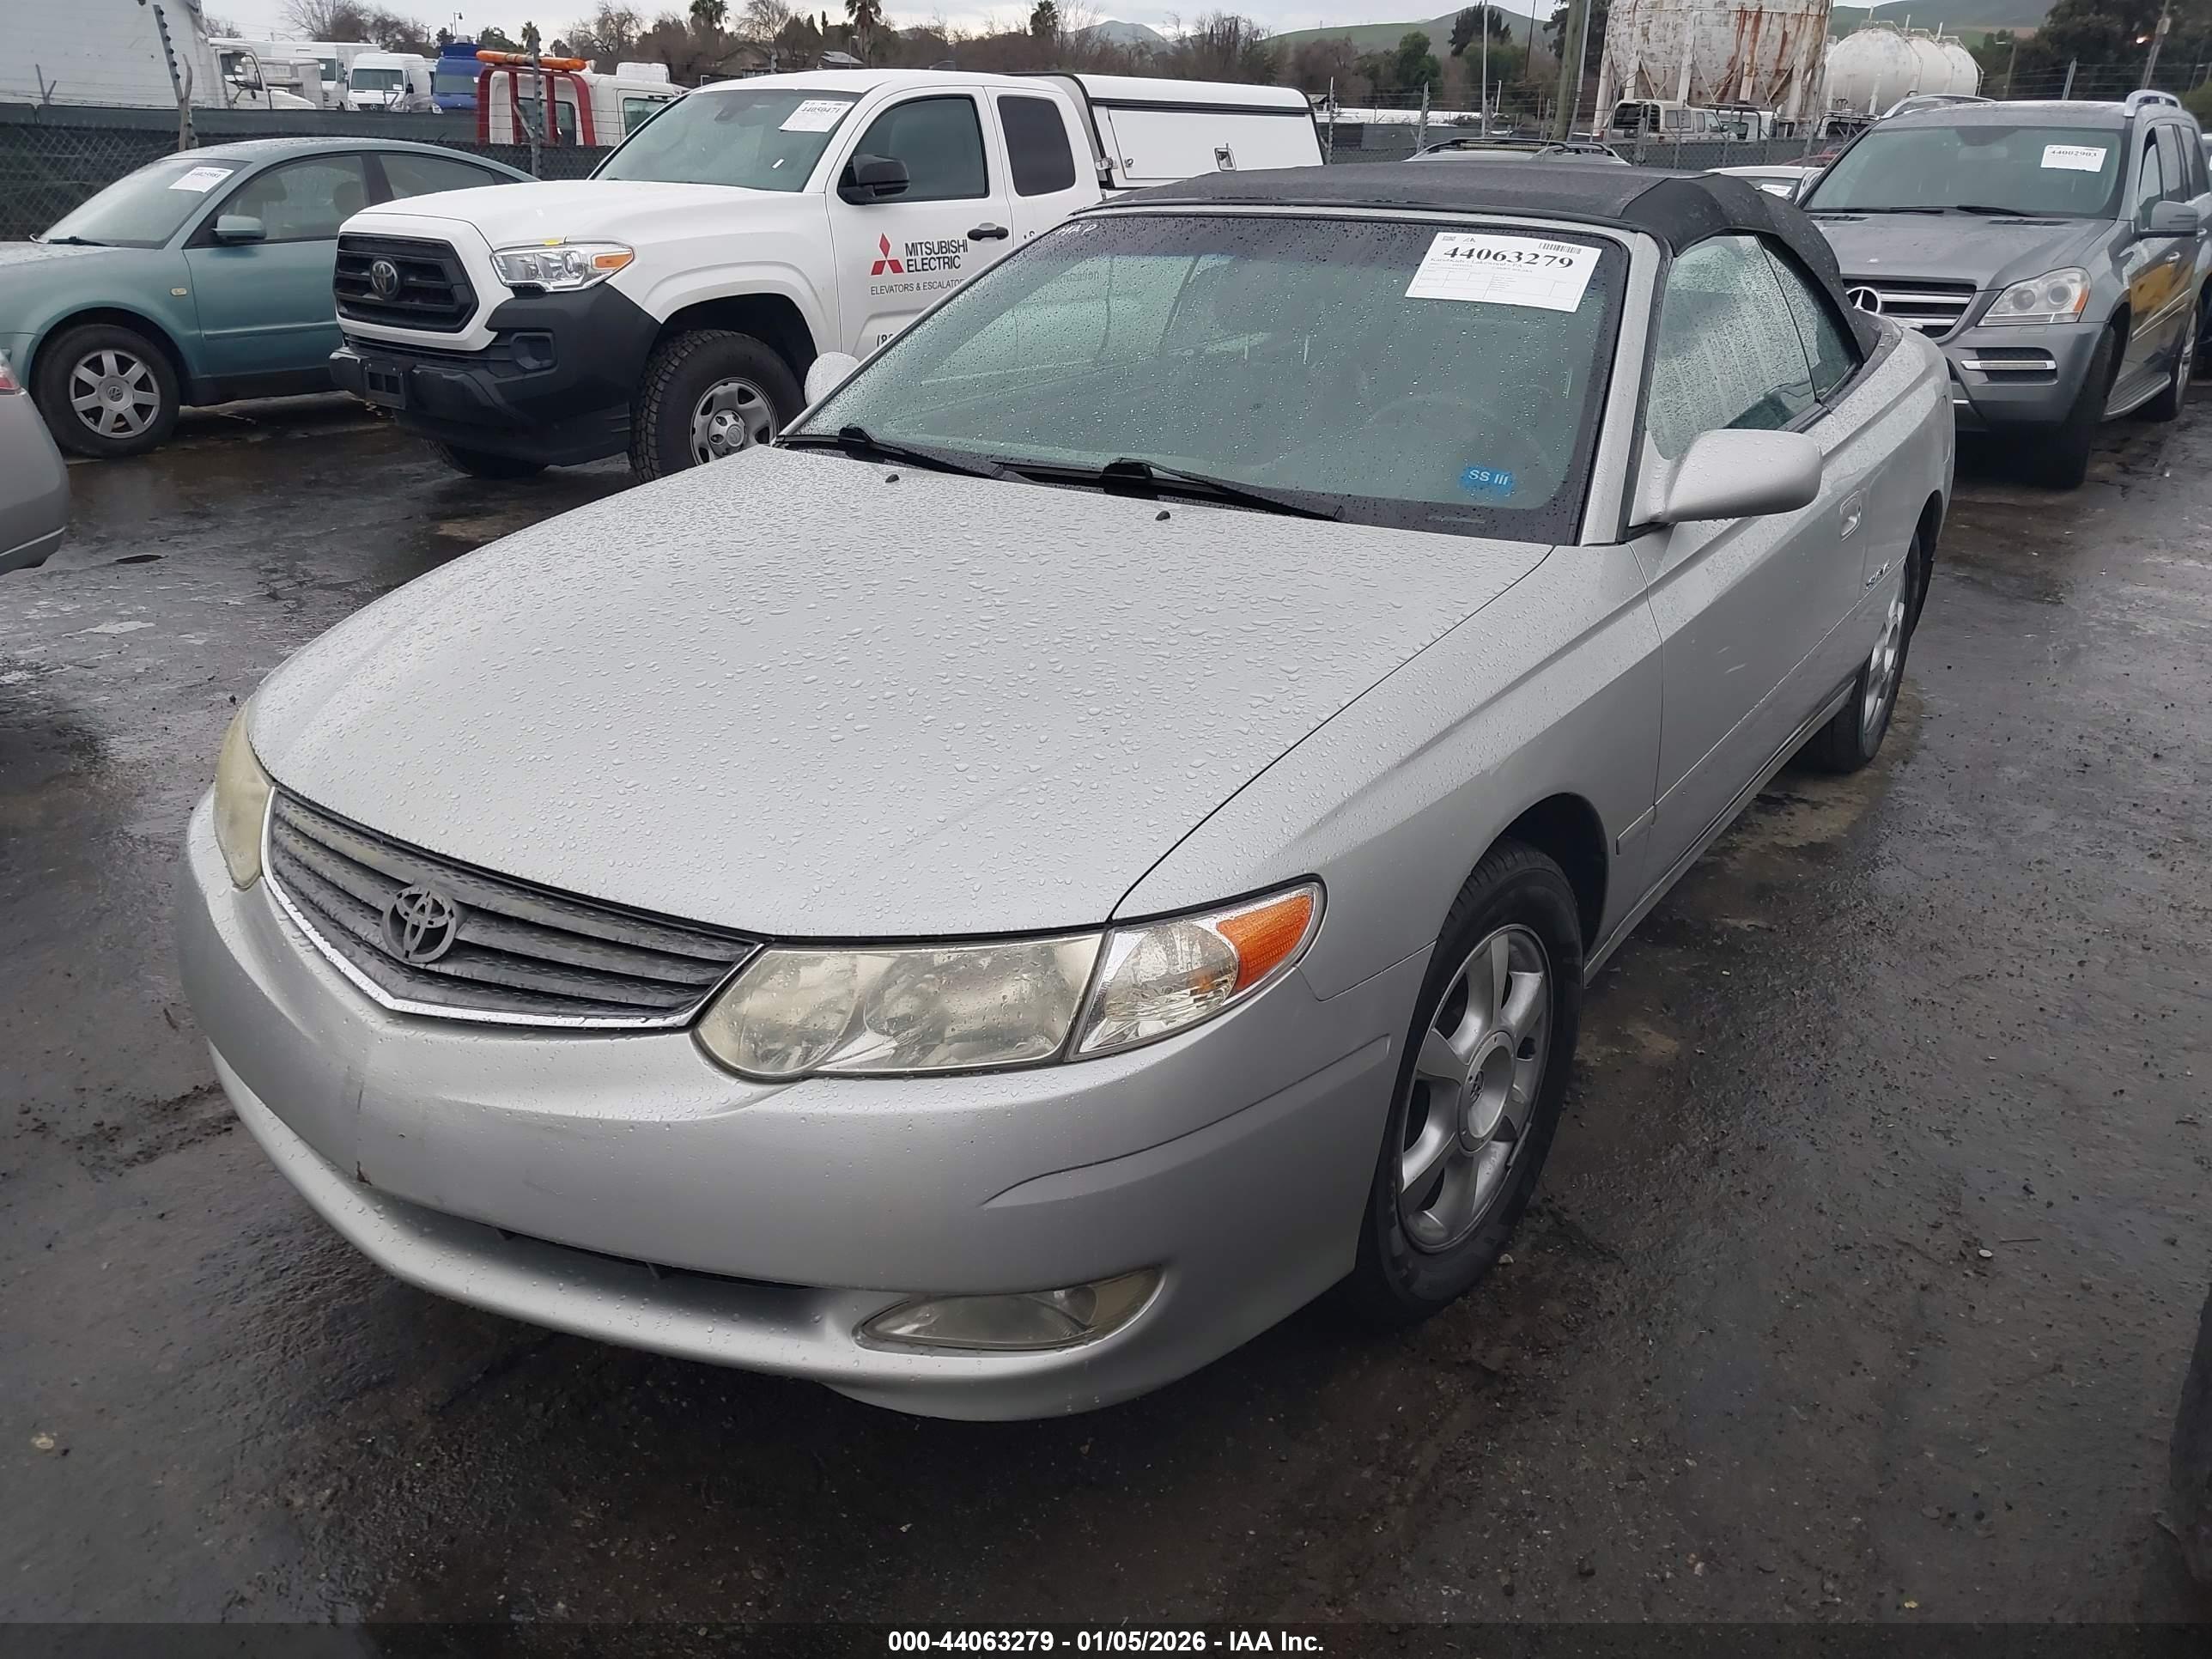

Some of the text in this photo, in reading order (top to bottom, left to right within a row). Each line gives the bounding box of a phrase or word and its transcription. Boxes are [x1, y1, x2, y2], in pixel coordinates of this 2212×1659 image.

[904, 239, 969, 257] MITSUBISHI
[906, 255, 962, 273] ELECTRIC
[1443, 246, 1574, 269] 44063279
[870, 283, 915, 295] ELEVATORS
[915, 283, 921, 291] &
[1468, 470, 1491, 482] SS
